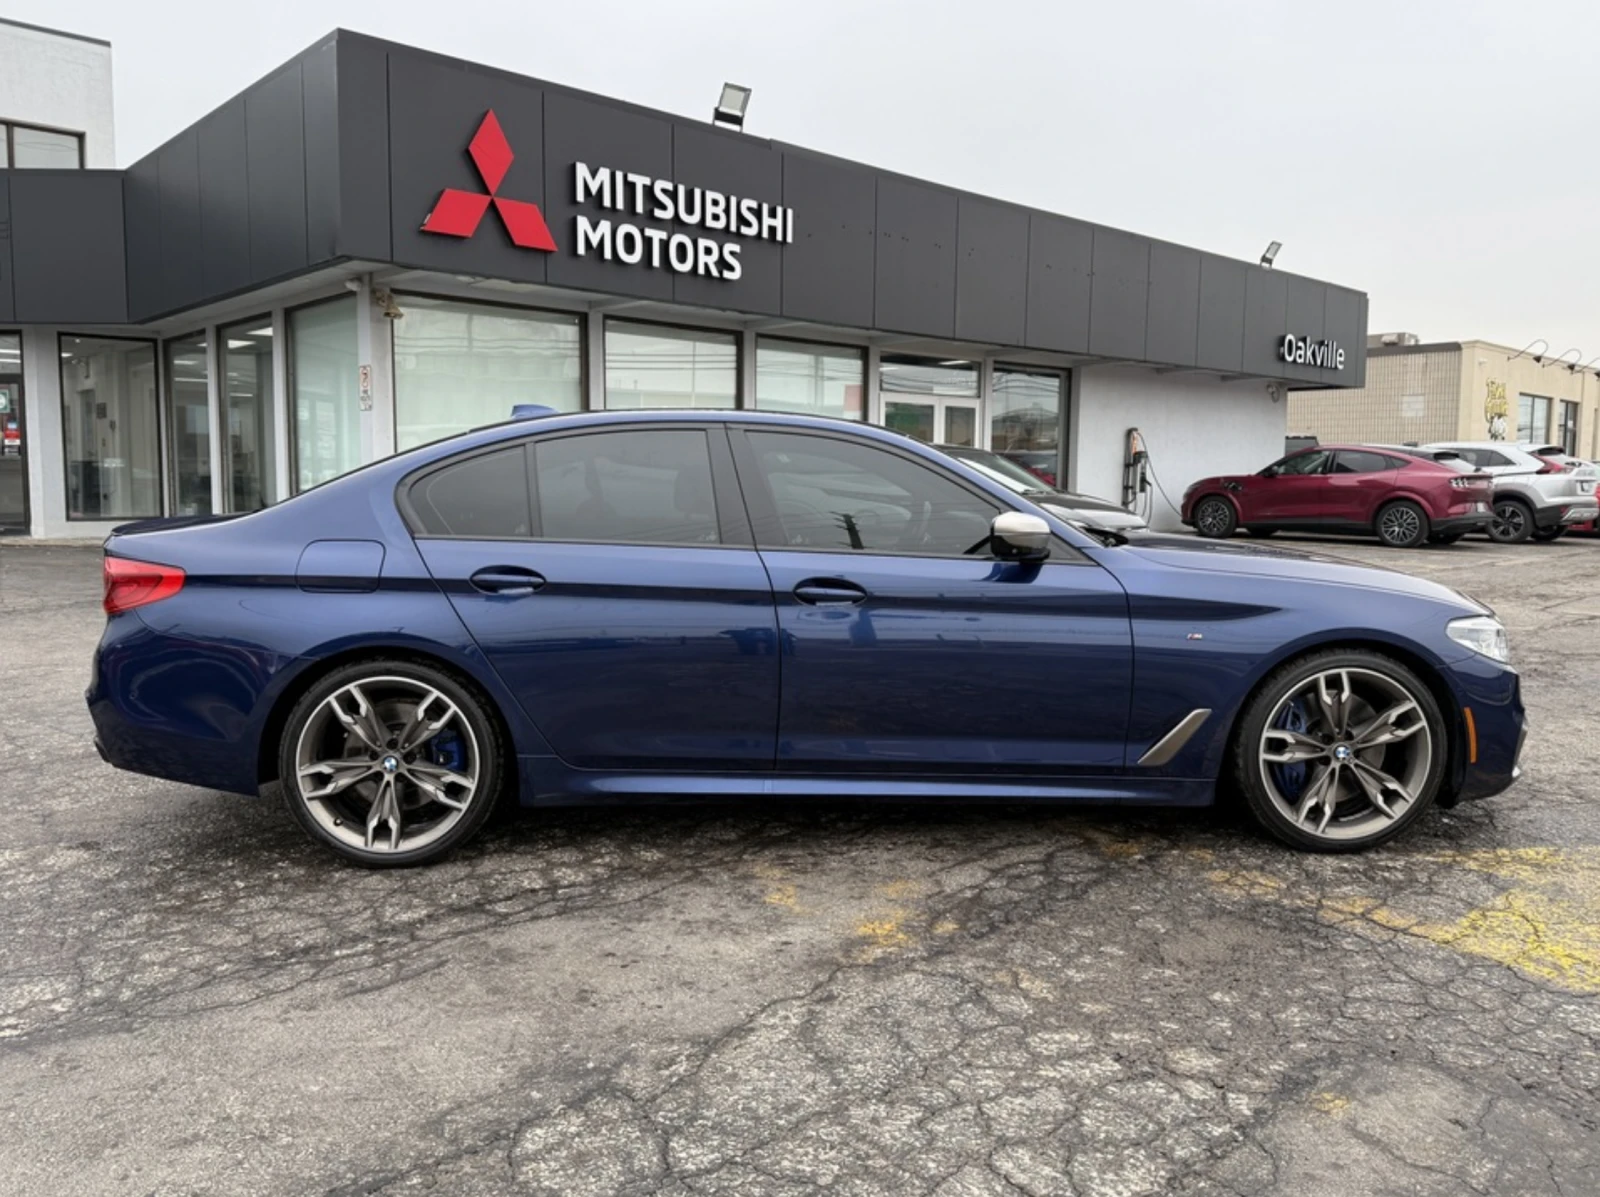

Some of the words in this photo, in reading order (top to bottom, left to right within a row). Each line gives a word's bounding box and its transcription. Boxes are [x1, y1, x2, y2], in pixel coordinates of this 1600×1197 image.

[575, 161, 794, 244] MITSUBISHI
[575, 214, 742, 281] MOTORS
[1284, 333, 1345, 370] Oakville
